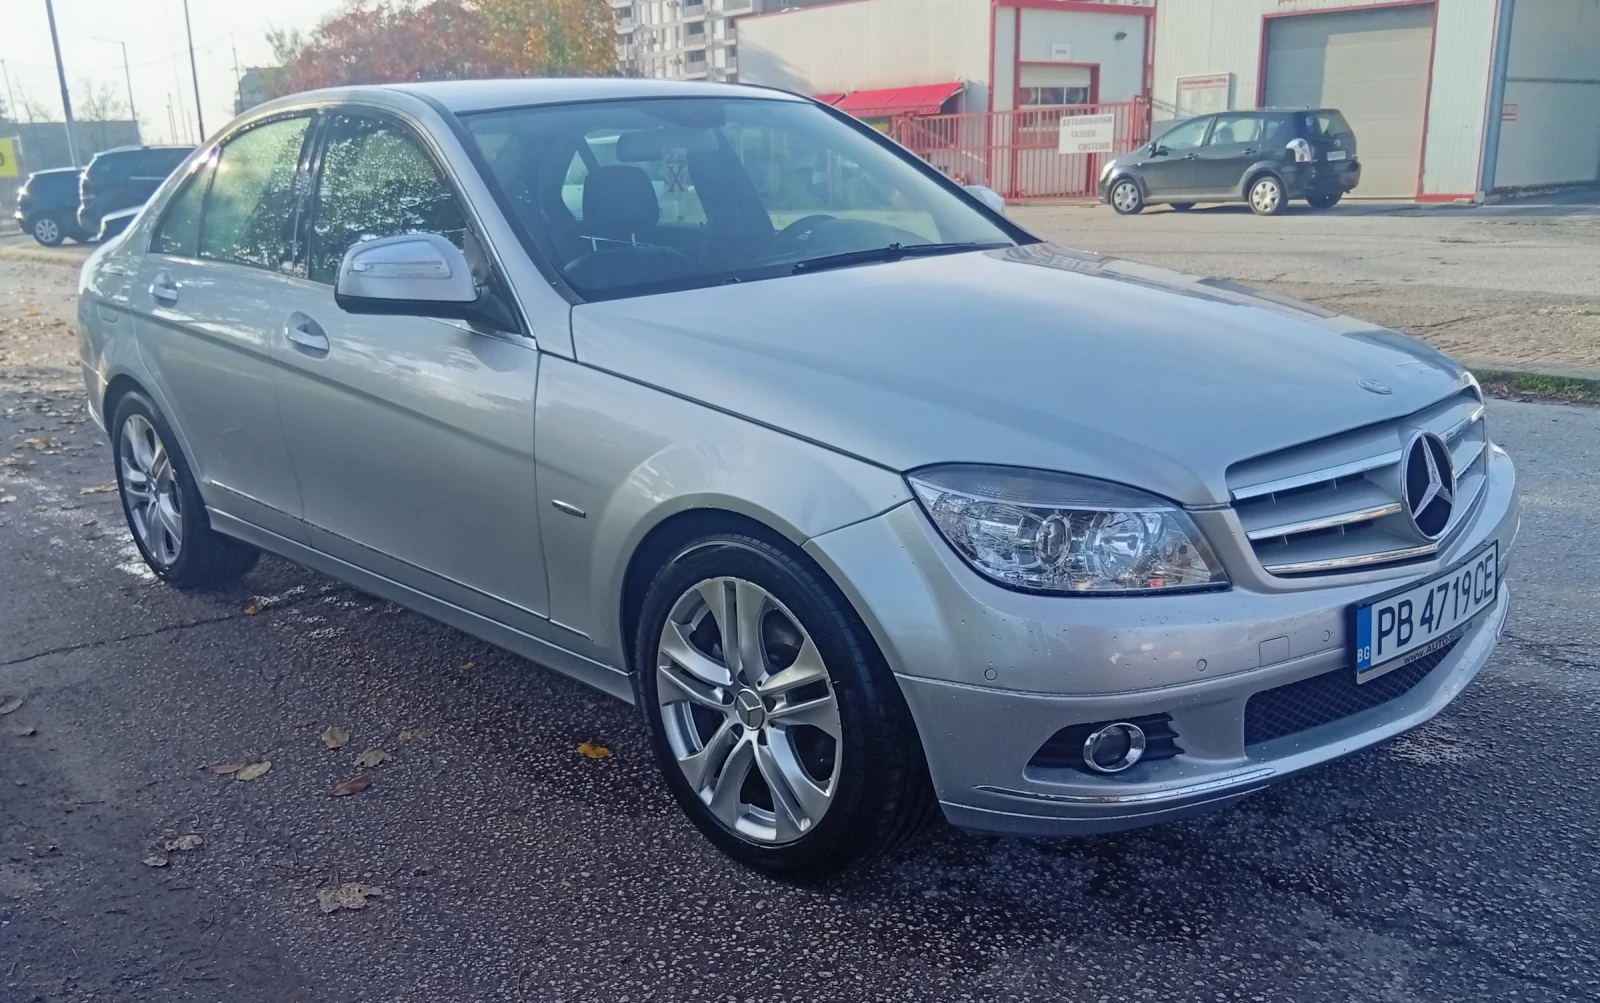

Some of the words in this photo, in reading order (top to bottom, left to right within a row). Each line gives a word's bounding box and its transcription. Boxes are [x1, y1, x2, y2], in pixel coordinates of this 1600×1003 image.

[1071, 130, 1096, 138] ГАЗОВИ
[1078, 142, 1110, 151] СИСТЕМИ
[1357, 646, 1370, 662] BG
